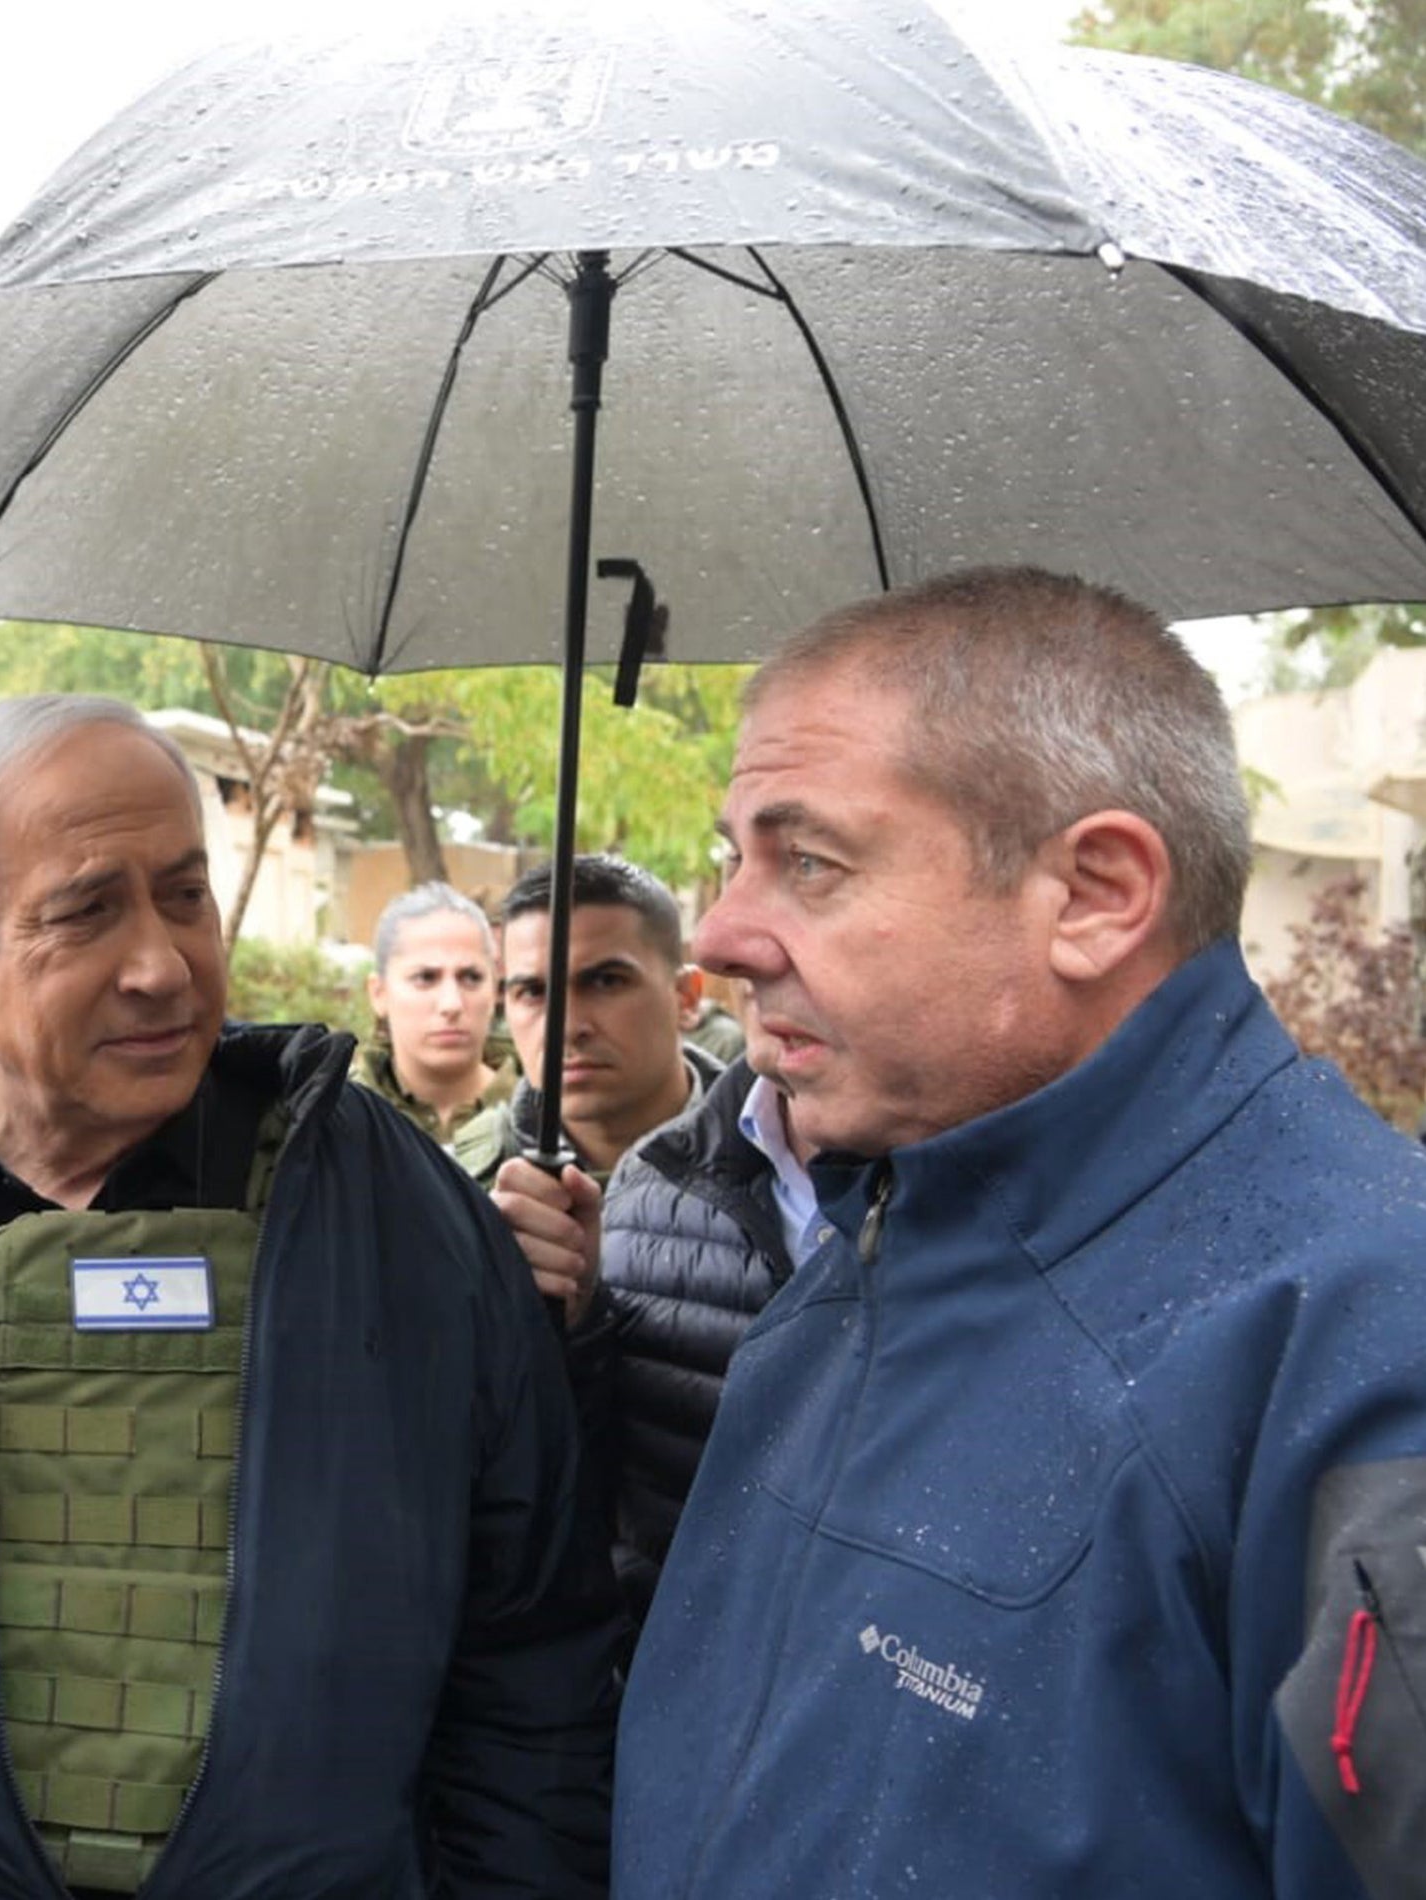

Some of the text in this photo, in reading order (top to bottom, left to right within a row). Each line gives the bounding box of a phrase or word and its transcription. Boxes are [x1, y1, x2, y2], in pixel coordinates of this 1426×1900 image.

[613, 144, 779, 173] משרד
[880, 1634, 984, 1703] Columbia
[895, 1669, 977, 1720] TITANIUM
